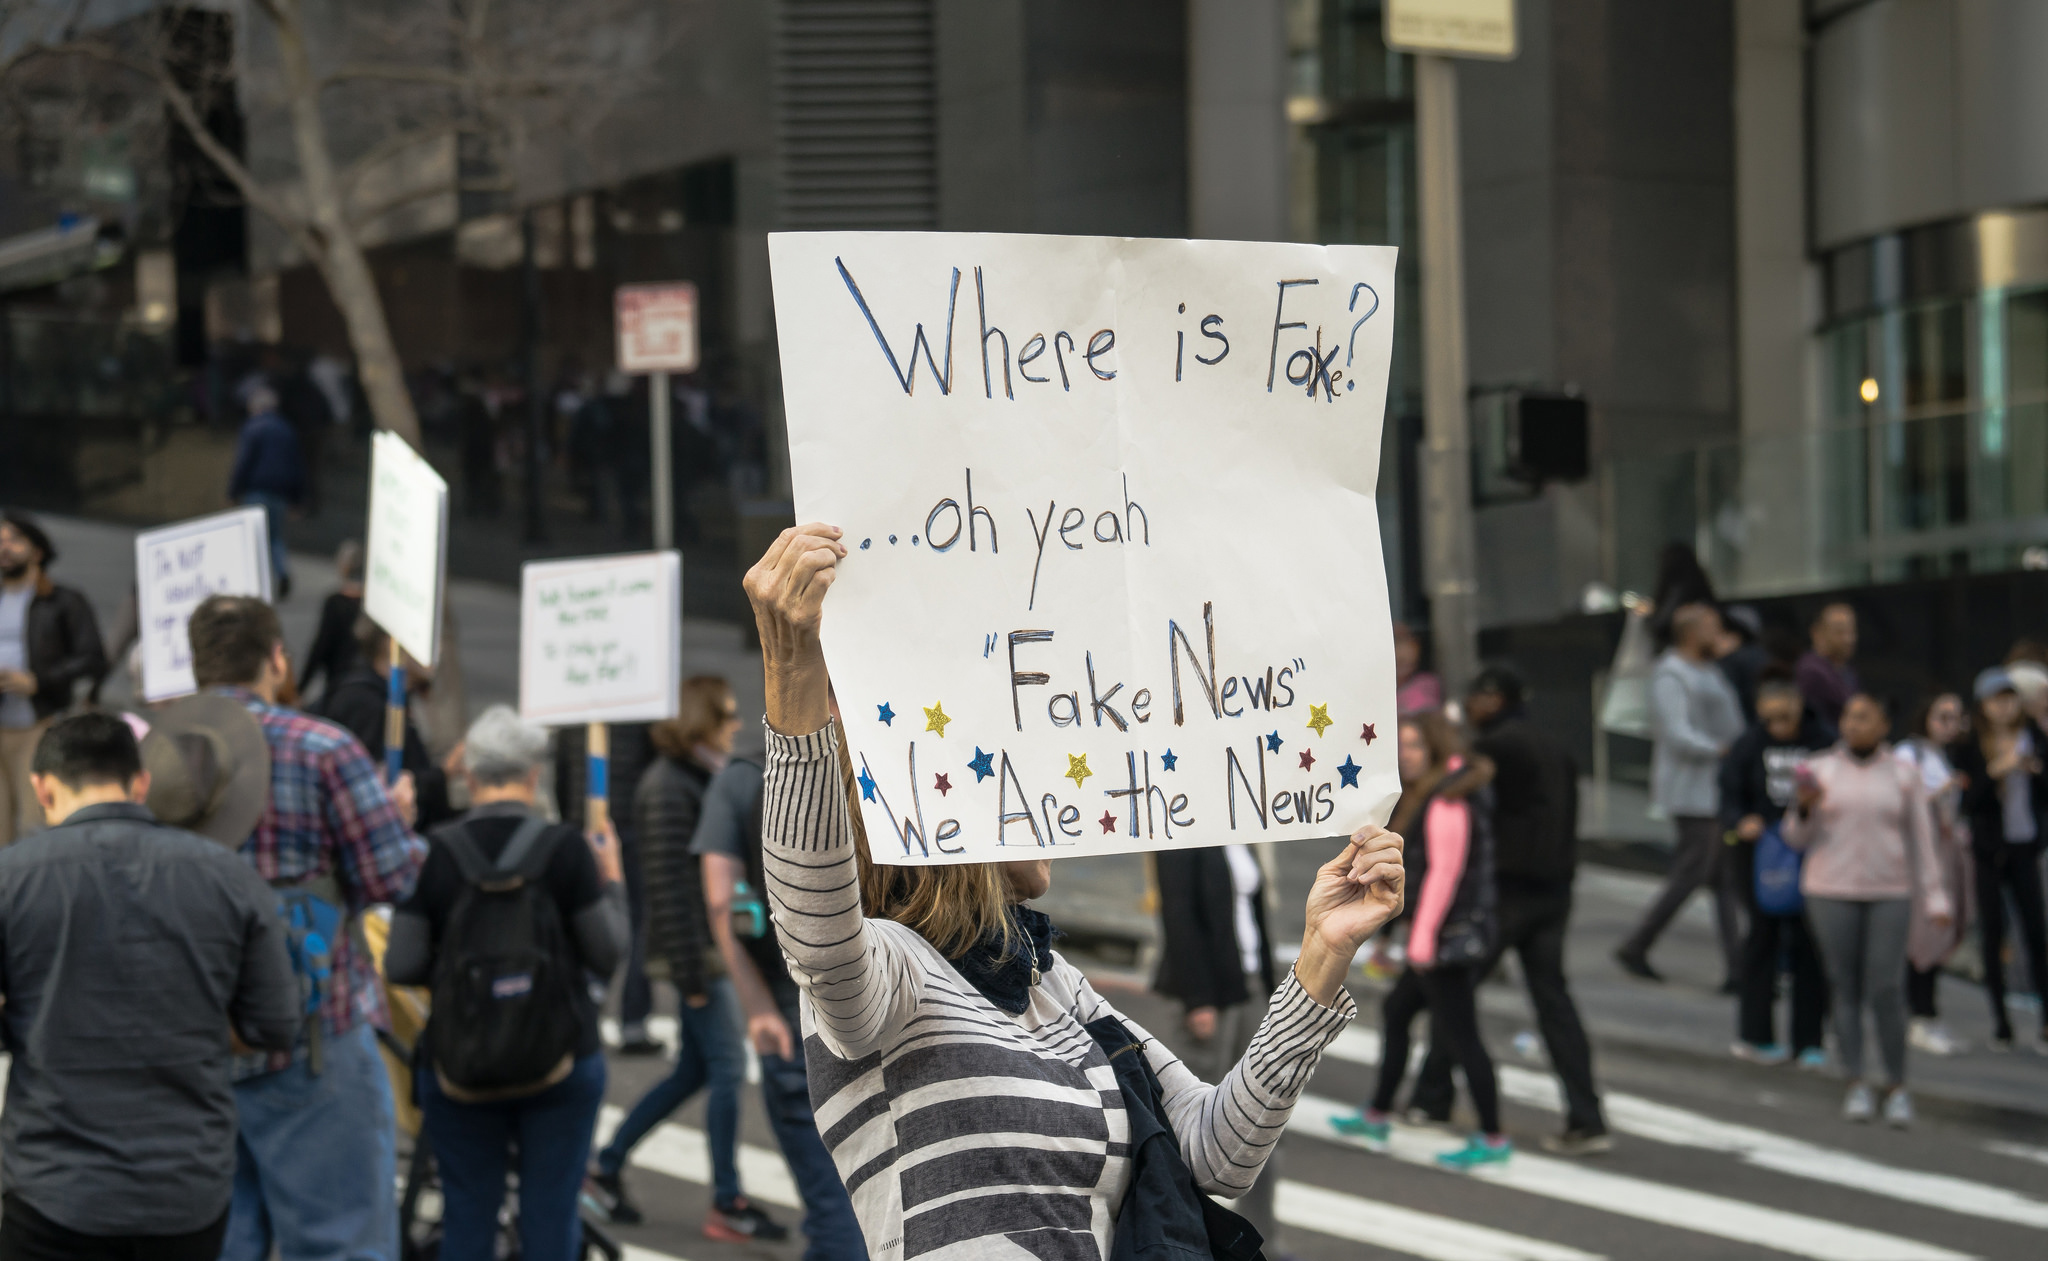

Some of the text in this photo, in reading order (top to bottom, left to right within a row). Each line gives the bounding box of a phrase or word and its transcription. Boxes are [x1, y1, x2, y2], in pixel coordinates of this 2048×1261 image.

[835, 256, 1118, 400] Where
[1175, 302, 1230, 382] is
[1027, 472, 1149, 611] yeah
[983, 601, 1306, 732] "Fake News"
[859, 735, 1335, 858] We Are the News
